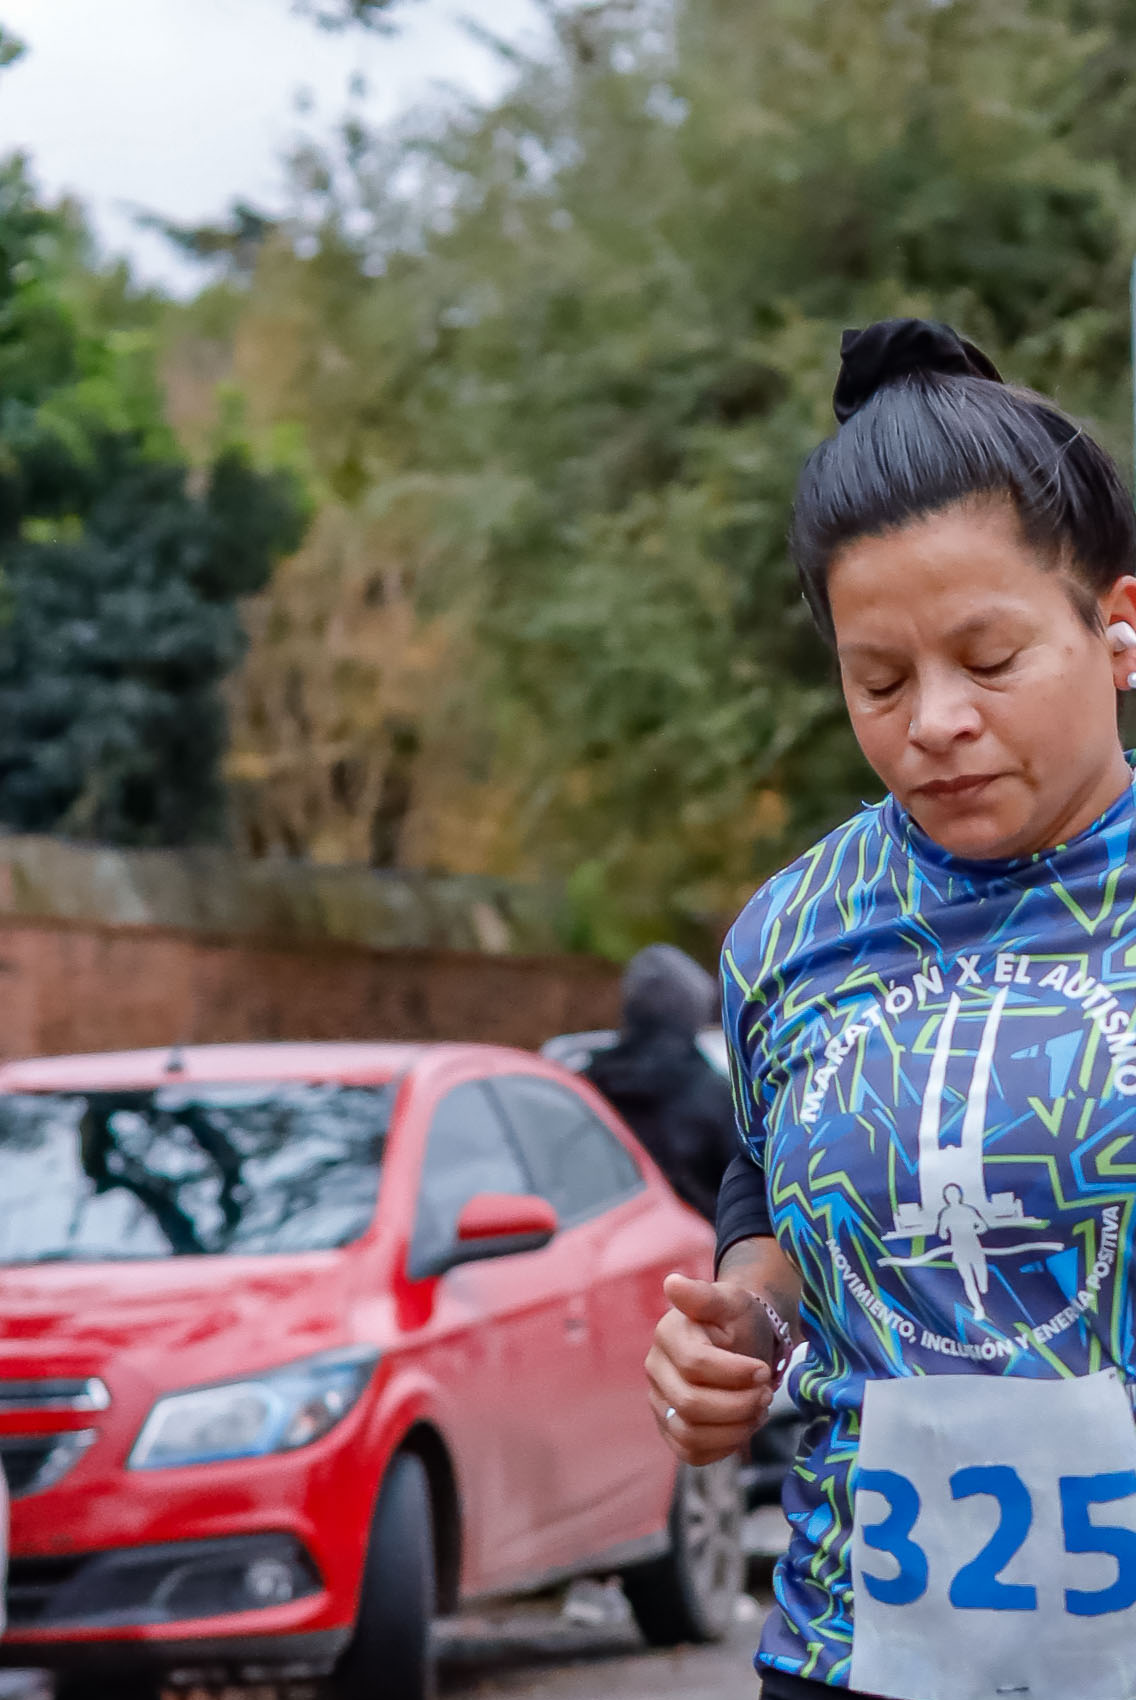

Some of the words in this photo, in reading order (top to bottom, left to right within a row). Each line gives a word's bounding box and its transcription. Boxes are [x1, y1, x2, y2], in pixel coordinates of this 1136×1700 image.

[800, 966, 944, 1123] MARATÓN
[956, 955, 982, 986] X
[994, 953, 1031, 985] EL
[1014, 1332, 1030, 1349] Y
[1085, 1205, 1120, 1290] POSITIVA
